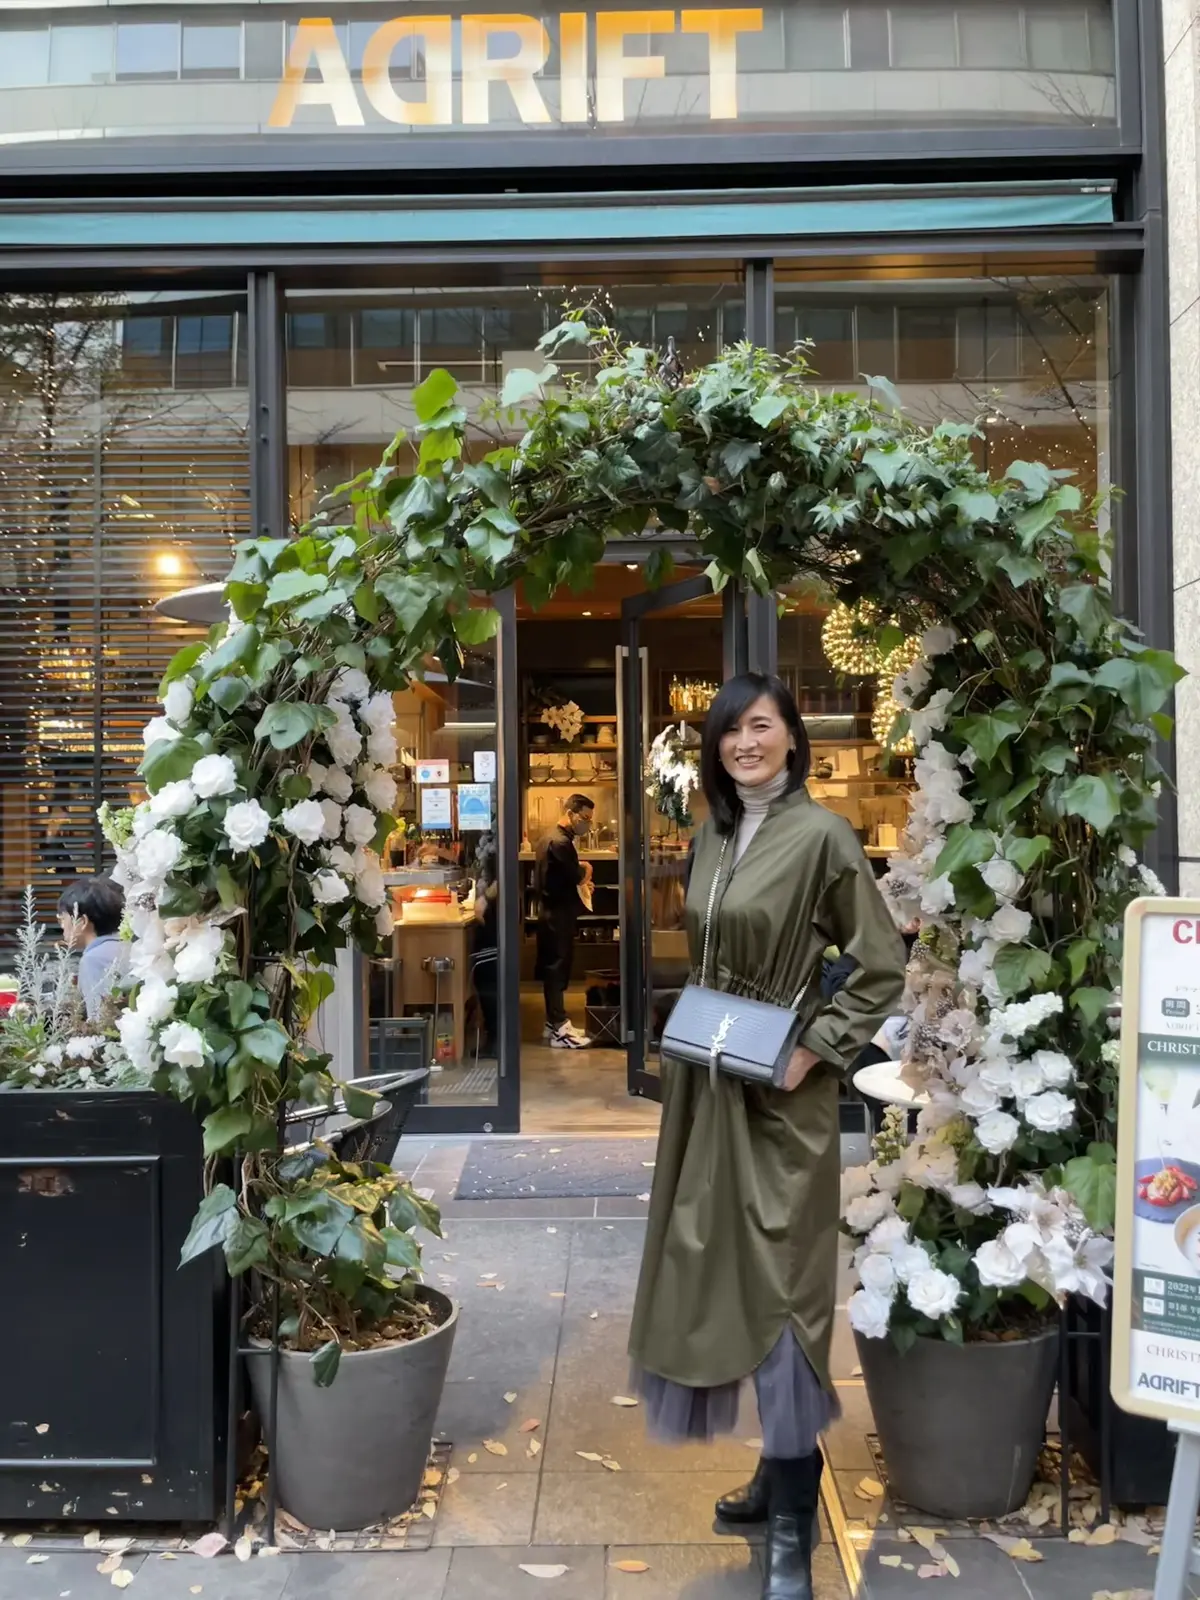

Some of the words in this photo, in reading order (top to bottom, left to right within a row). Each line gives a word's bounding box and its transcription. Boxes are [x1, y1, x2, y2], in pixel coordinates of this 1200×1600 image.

[267, 8, 763, 127] ADRIFT
[1172, 919, 1200, 945] C
[1147, 1040, 1200, 1055] CHRIST
[1146, 1344, 1200, 1364] CHRIST
